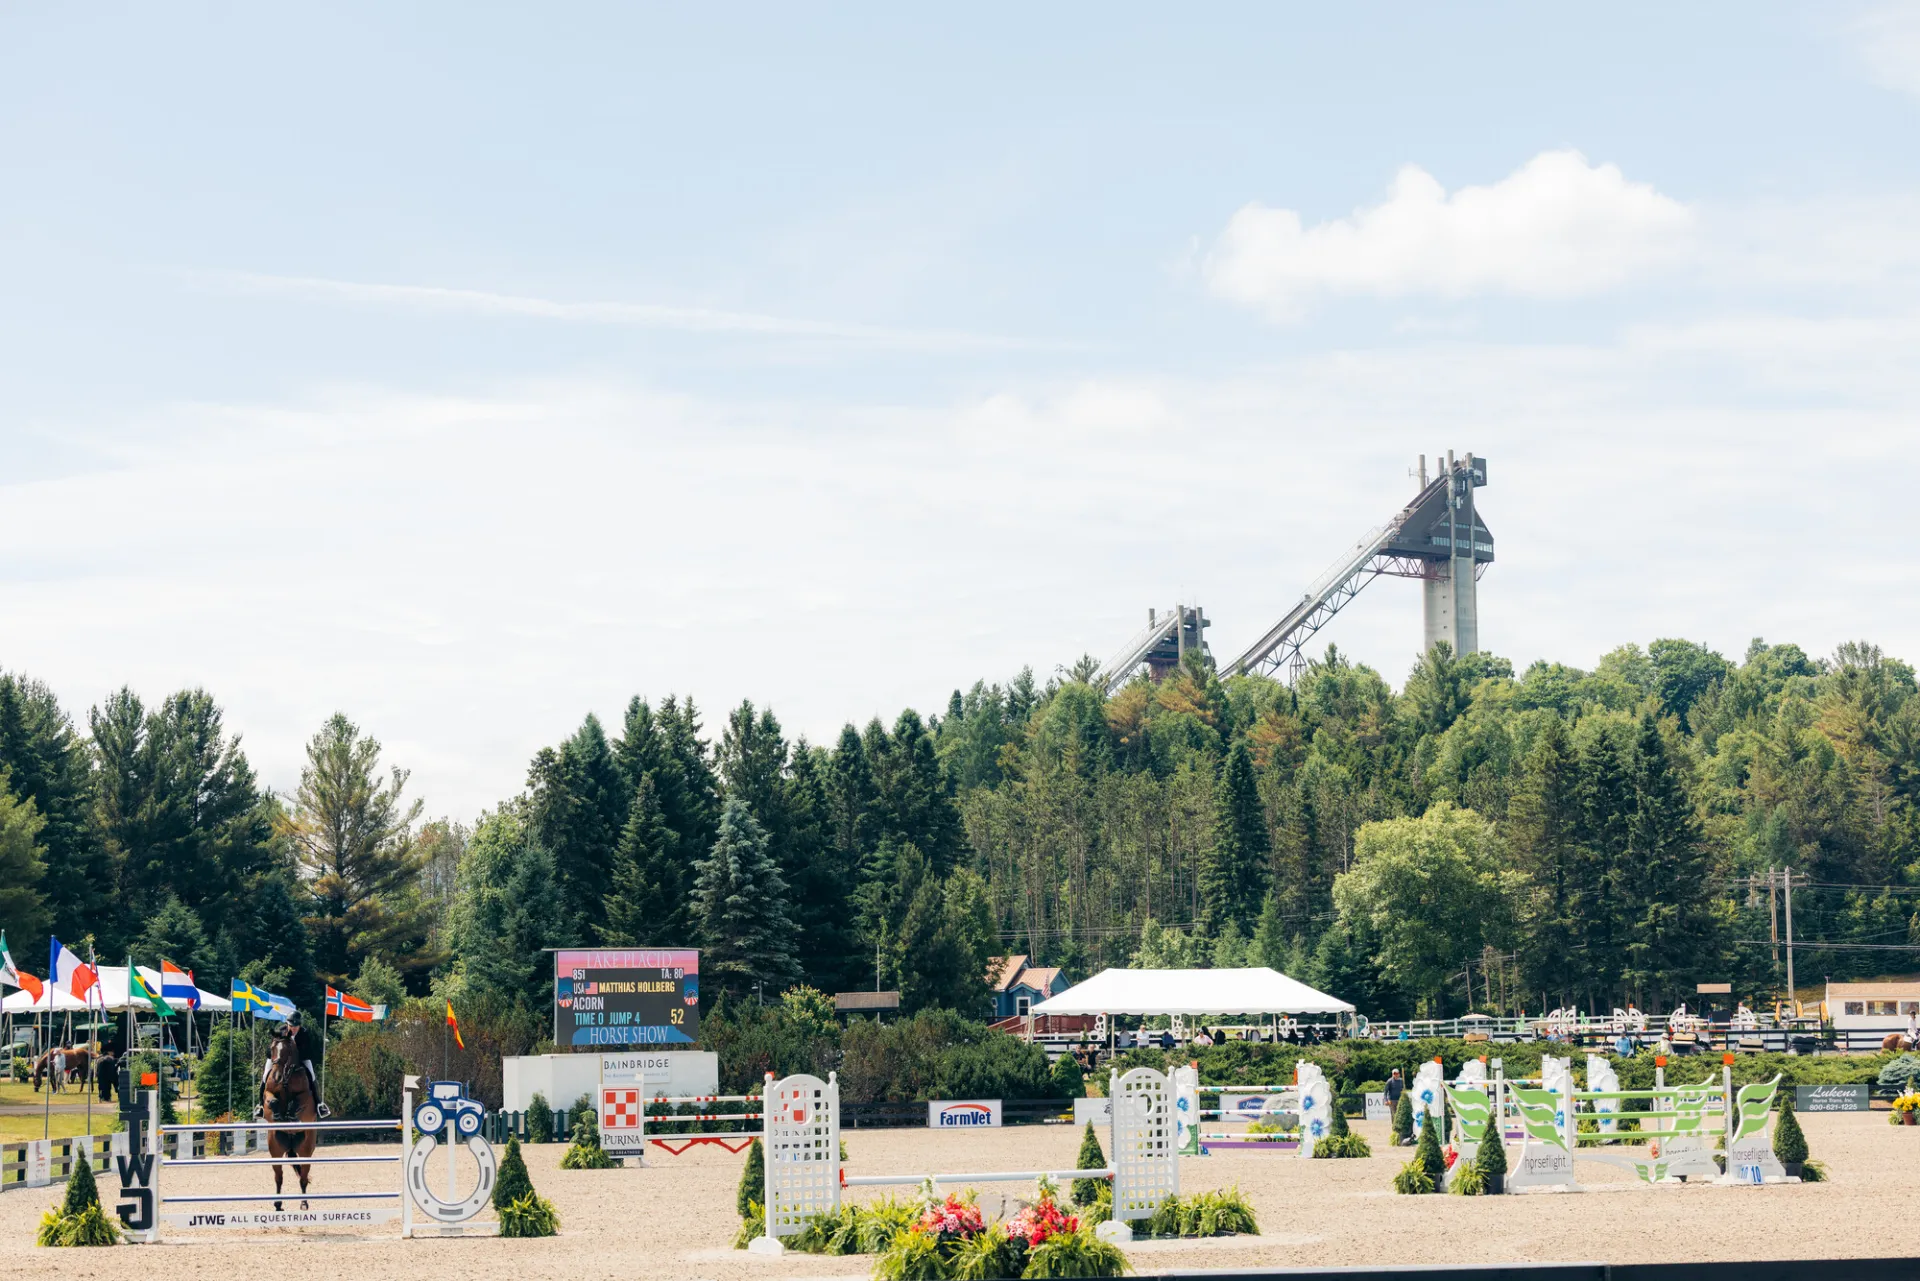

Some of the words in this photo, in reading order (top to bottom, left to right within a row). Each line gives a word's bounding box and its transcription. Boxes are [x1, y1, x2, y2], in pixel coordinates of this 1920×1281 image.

[586, 951, 618, 968] LAKE
[623, 951, 672, 968] PLACID
[572, 969, 586, 980] 851
[661, 968, 672, 979] TA:
[673, 968, 684, 979] 80
[573, 983, 585, 994] USA
[599, 982, 636, 993] MATTHIAS
[637, 981, 675, 993] HOLLBERG
[572, 996, 604, 1010] ACORN
[574, 1012, 595, 1025] TIME
[609, 1012, 632, 1025] JUMP
[634, 1012, 640, 1024] 4
[670, 1008, 684, 1024] 52
[590, 1026, 629, 1044] HORSE
[632, 1026, 668, 1043] SHOW
[603, 1059, 669, 1070] BAINBRIDGE
[1808, 1086, 1858, 1098] Lukens
[940, 1111, 992, 1125] FarmVet
[604, 1134, 640, 1146] PURINA
[1524, 1154, 1566, 1170] horseflight
[1732, 1148, 1769, 1162] horseflight
[1751, 1165, 1762, 1183] 10
[189, 1215, 226, 1226] JTWG
[254, 1214, 317, 1224] EQUESTRIAN
[322, 1212, 372, 1221] SURFACES
